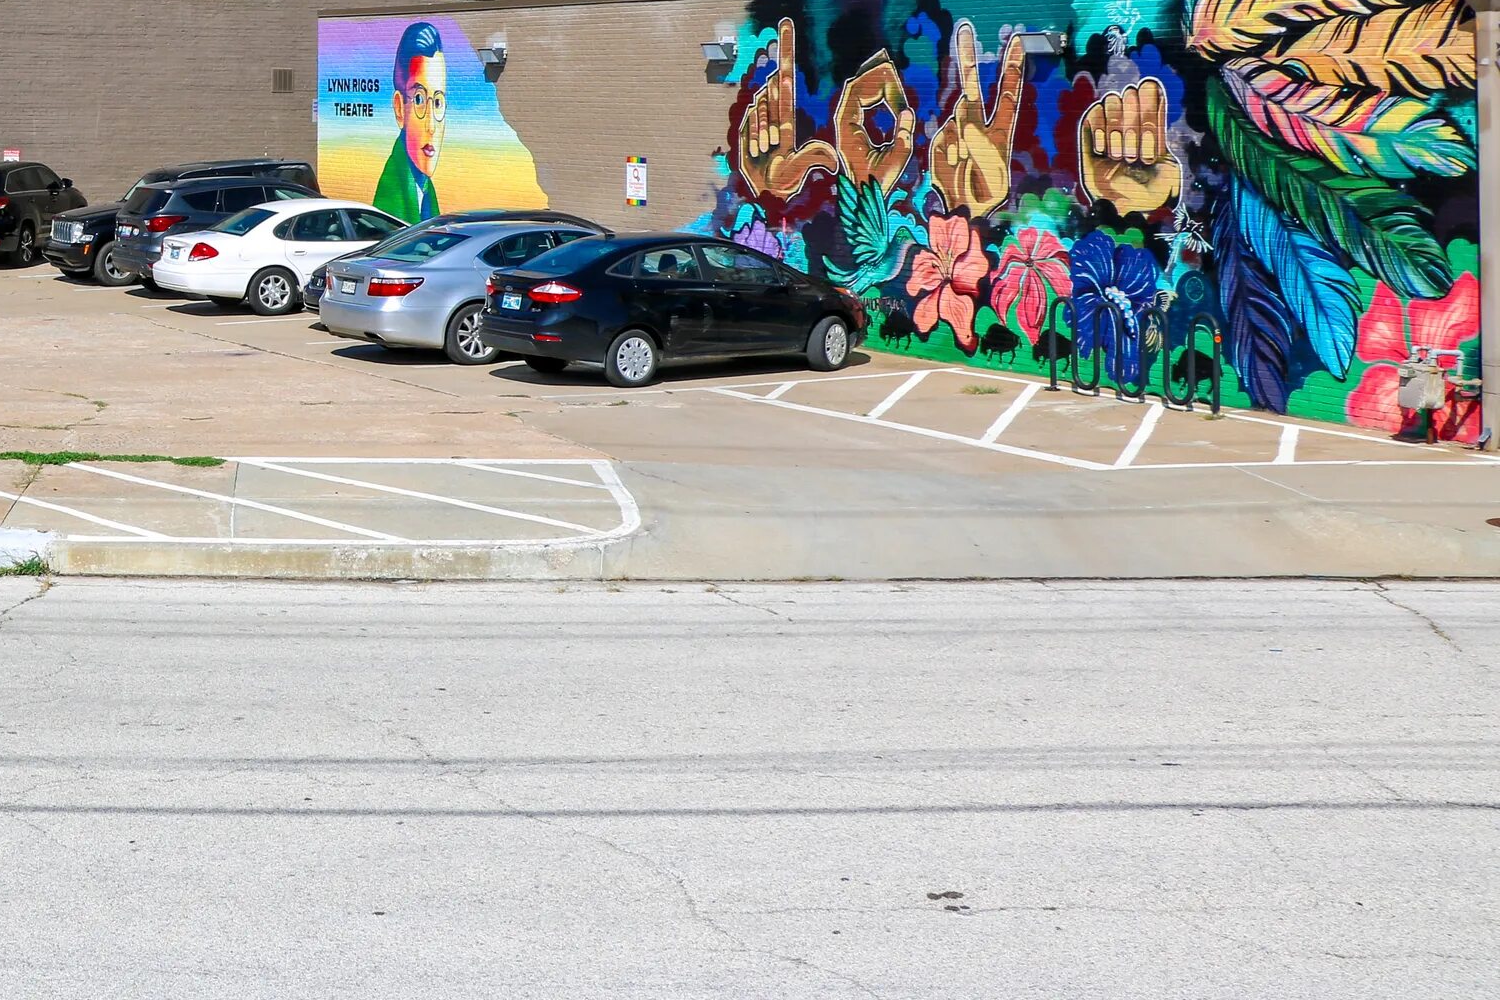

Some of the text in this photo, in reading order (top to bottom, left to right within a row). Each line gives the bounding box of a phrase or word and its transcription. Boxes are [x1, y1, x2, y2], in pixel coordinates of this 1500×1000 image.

[327, 78, 380, 93] LYNN RIGGS
[334, 102, 374, 117] THEATRE
